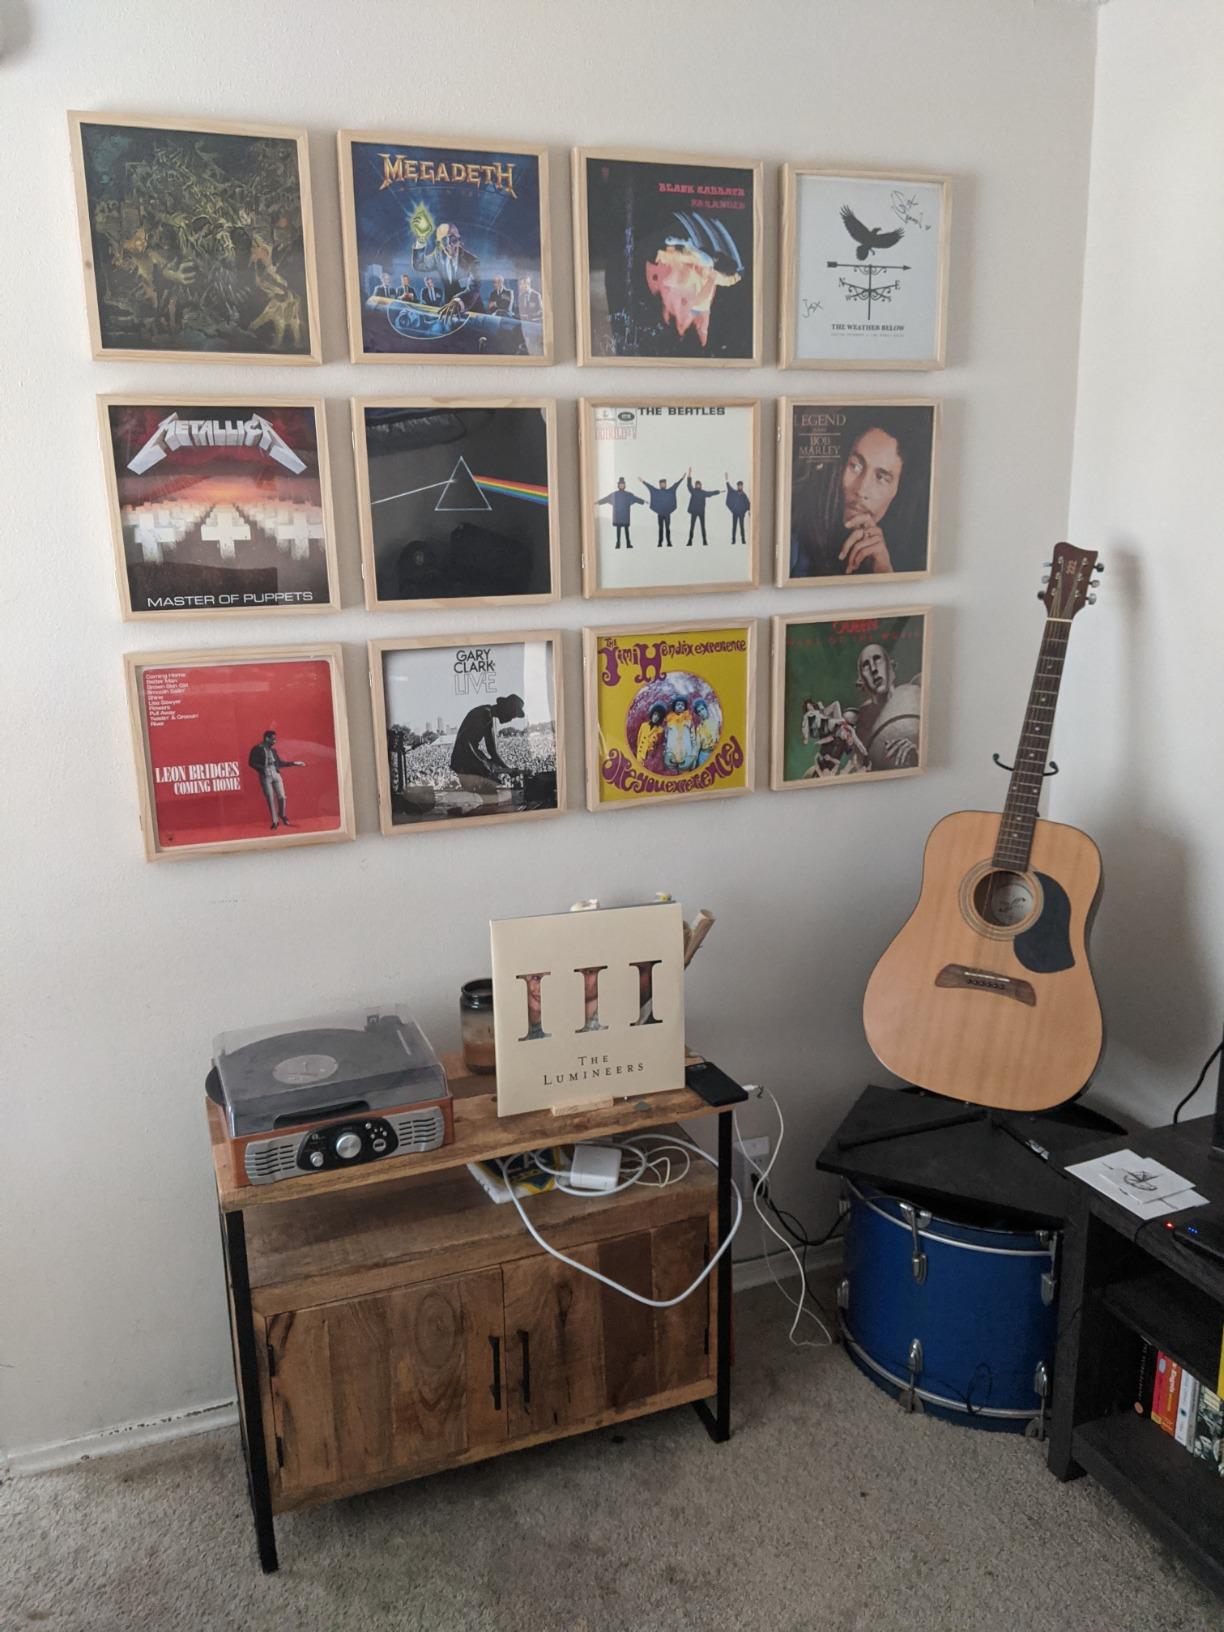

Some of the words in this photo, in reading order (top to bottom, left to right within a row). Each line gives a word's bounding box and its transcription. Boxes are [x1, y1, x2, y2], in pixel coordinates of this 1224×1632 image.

[377, 153, 517, 199] MEGADETH
[658, 183, 694, 193] BLACK
[696, 186, 745, 197] SABBATH
[638, 407, 662, 416] THE
[668, 407, 726, 416] BEATLES
[795, 414, 847, 426] LEGEND
[127, 411, 308, 475] METALLICA
[799, 445, 840, 456] MARLEY
[147, 595, 215, 608] MASTER
[218, 594, 240, 605] OF
[243, 591, 313, 603] PUPPETS
[456, 648, 491, 661] GARY
[453, 660, 495, 673] CLARK
[454, 671, 498, 695] LIVE
[155, 765, 186, 783] LEON
[188, 761, 240, 781] BRIDGES
[174, 780, 211, 795] COMING
[211, 777, 241, 792] HOME
[578, 1055, 609, 1066] THE
[543, 1063, 645, 1085] LUMINEERS
